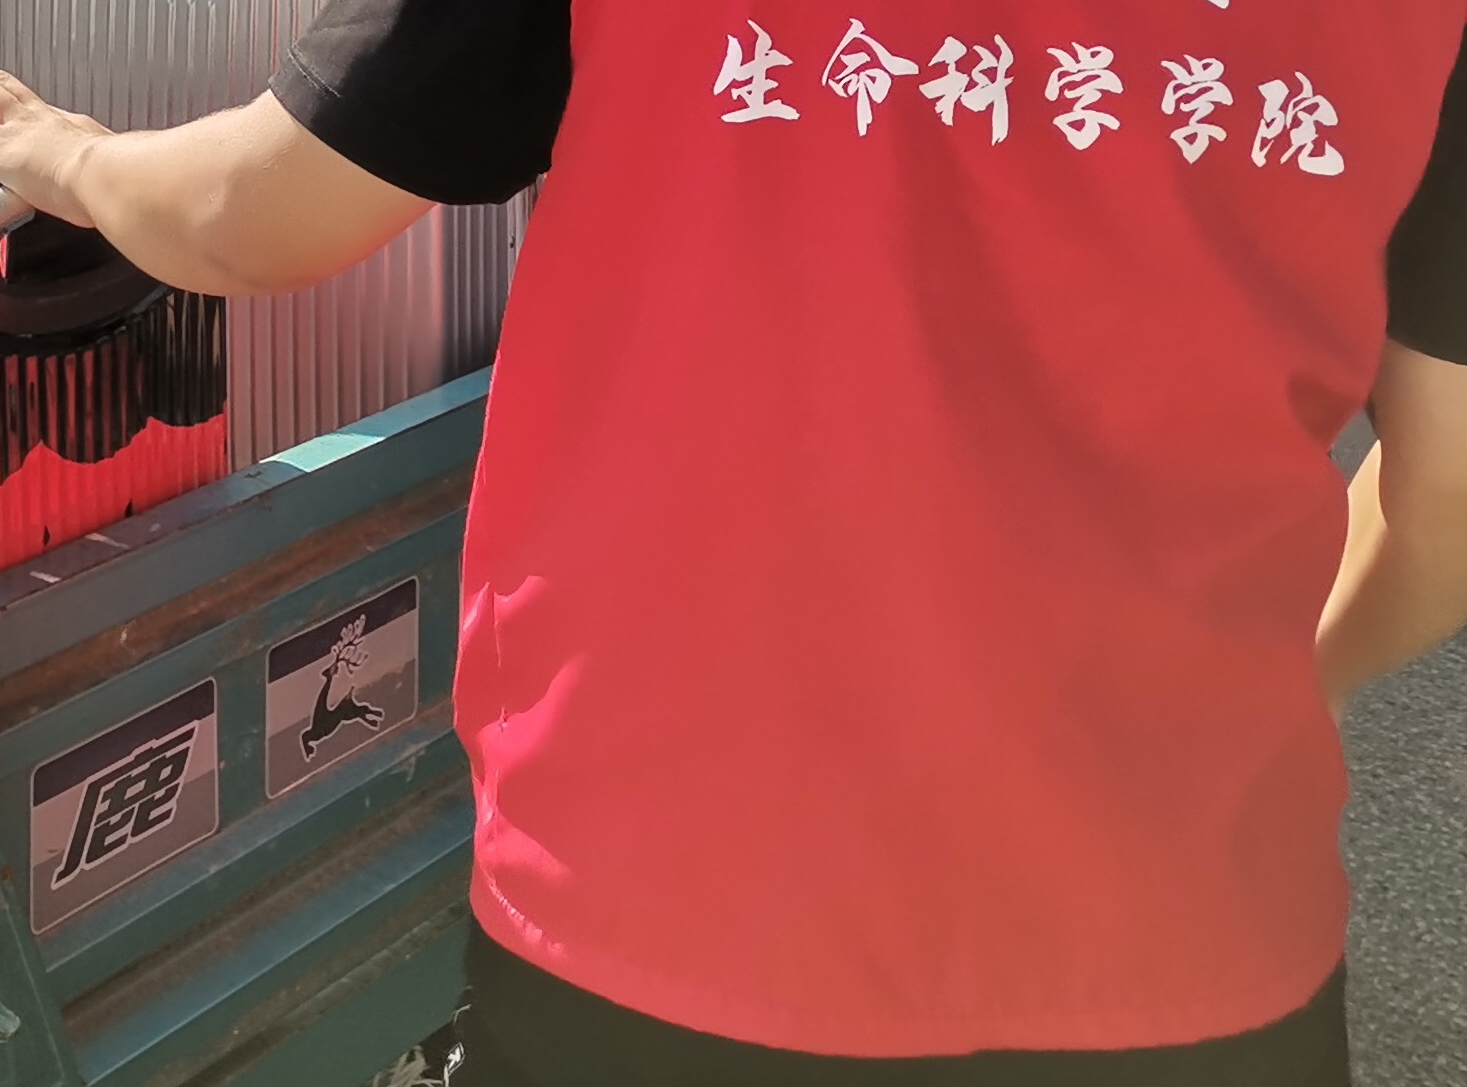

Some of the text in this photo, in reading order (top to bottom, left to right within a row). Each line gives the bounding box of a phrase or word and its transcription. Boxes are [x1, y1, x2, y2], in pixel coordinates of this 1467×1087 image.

[712, 17, 1345, 177] 生命科学学院
[51, 720, 200, 891] 鹿
